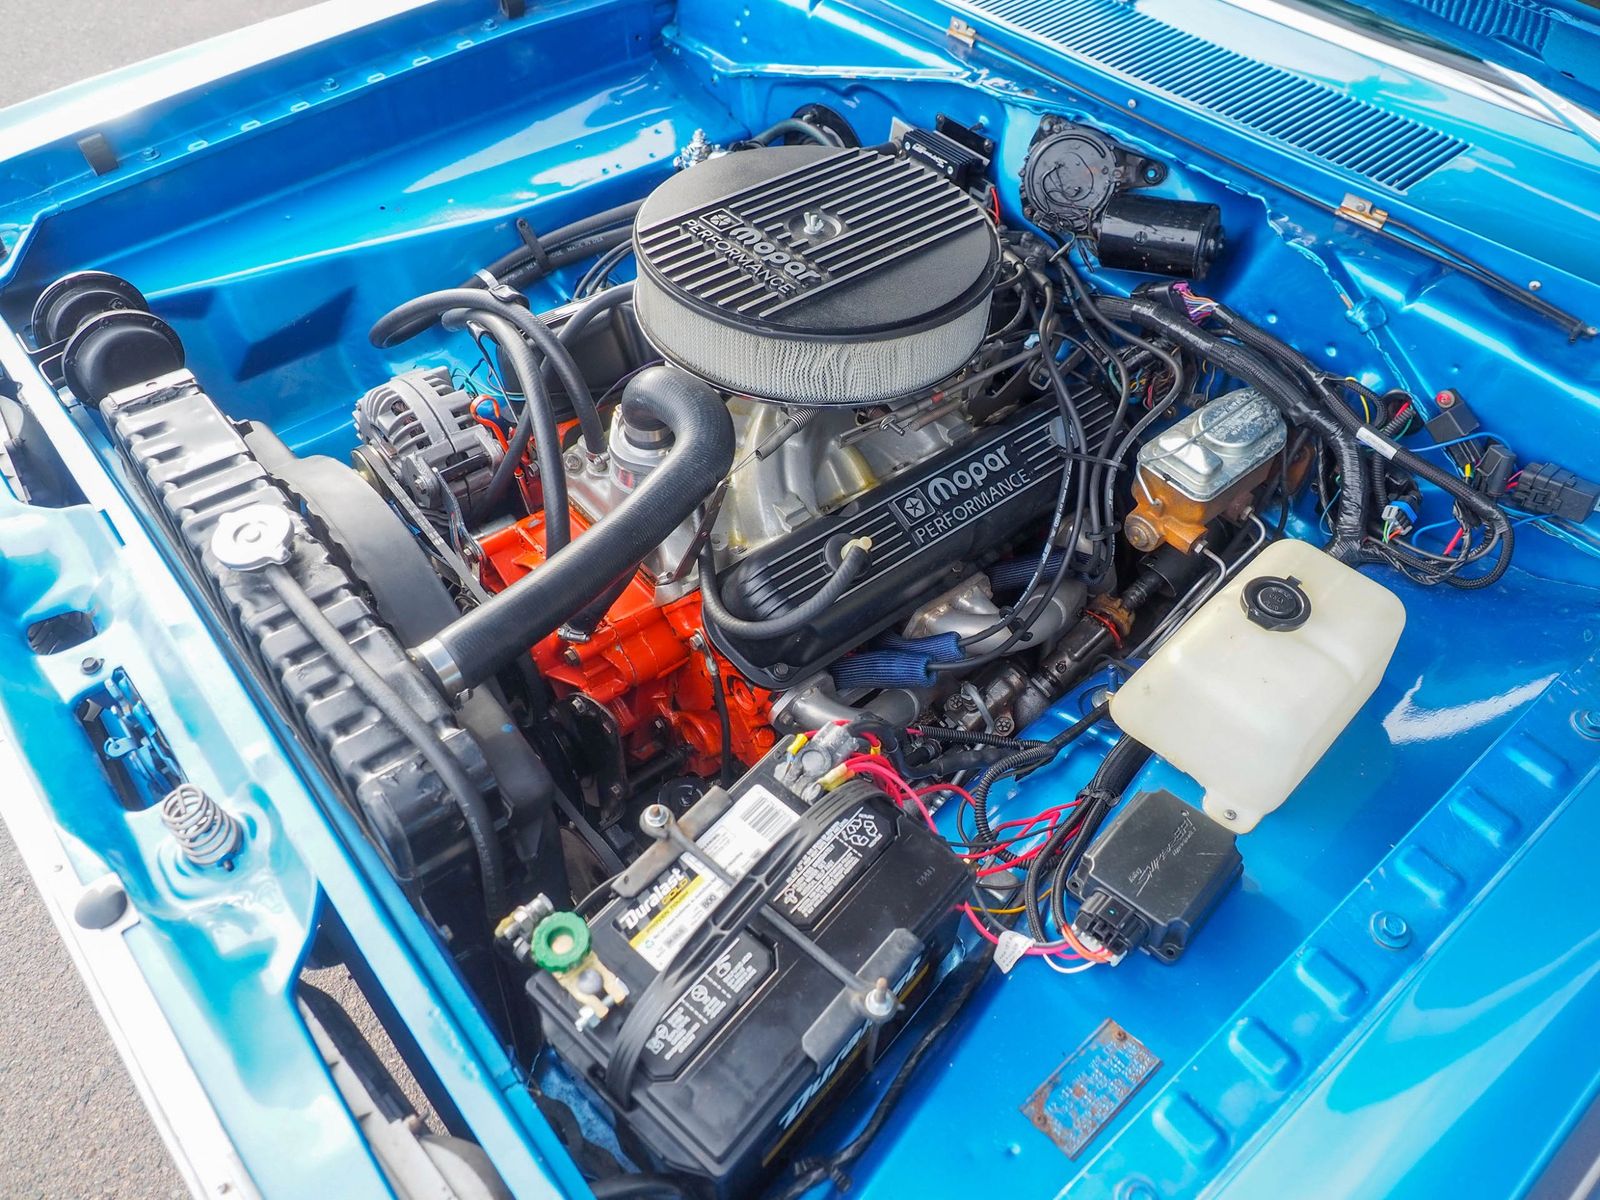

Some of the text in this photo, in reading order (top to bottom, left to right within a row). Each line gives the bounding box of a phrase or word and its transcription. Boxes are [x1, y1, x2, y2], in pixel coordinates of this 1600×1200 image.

[681, 218, 796, 296] PERFORMANCE
[914, 468, 1031, 544] PERFORMANCE
[618, 867, 686, 930] Duralast
[661, 877, 688, 905] GOLD
[702, 894, 717, 909] 800
[778, 954, 923, 1130] Duralst
